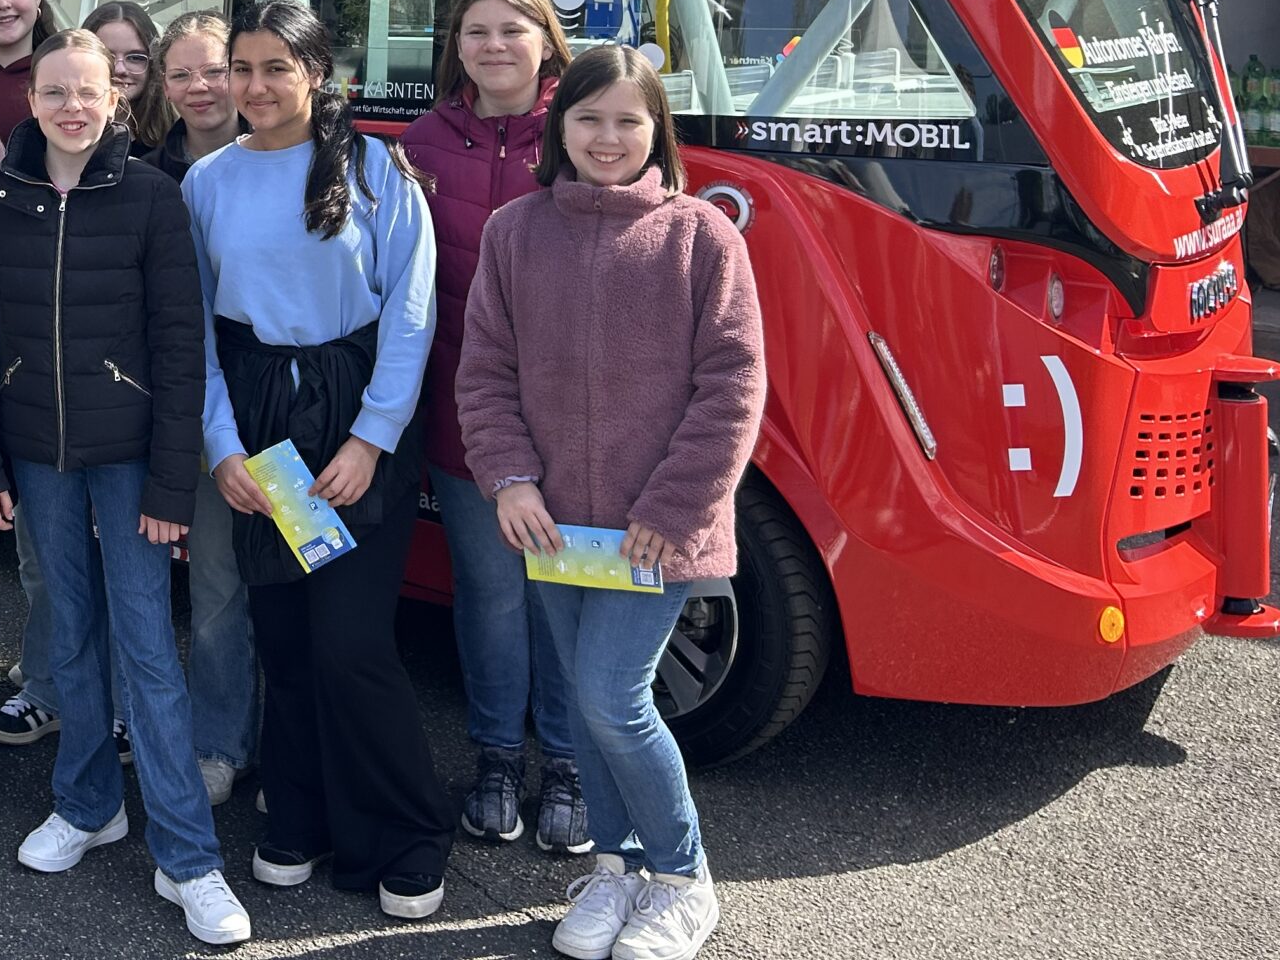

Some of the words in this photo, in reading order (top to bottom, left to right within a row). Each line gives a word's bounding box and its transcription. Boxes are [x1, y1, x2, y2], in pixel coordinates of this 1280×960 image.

[362, 105, 371, 113] für
[372, 105, 405, 115] Wirtschaft
[406, 108, 418, 116] und
